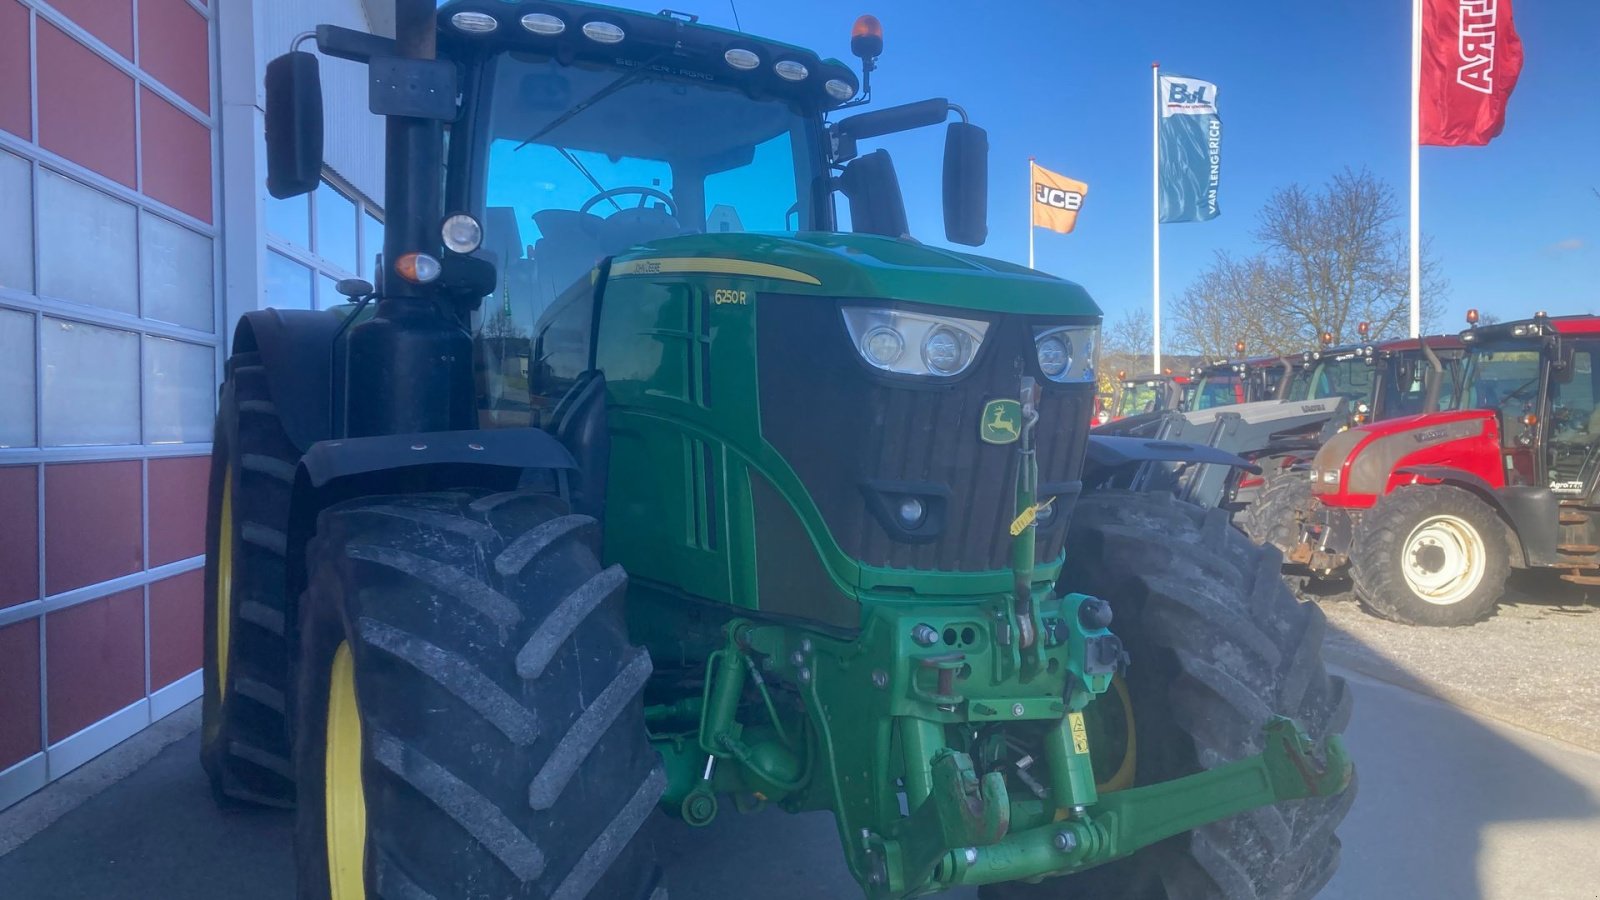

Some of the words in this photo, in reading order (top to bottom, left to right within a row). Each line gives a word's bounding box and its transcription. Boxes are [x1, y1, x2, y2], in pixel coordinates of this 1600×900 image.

[1208, 120, 1221, 187] LENGERICH
[1036, 183, 1083, 211] JCB
[1207, 189, 1217, 215] VAN
